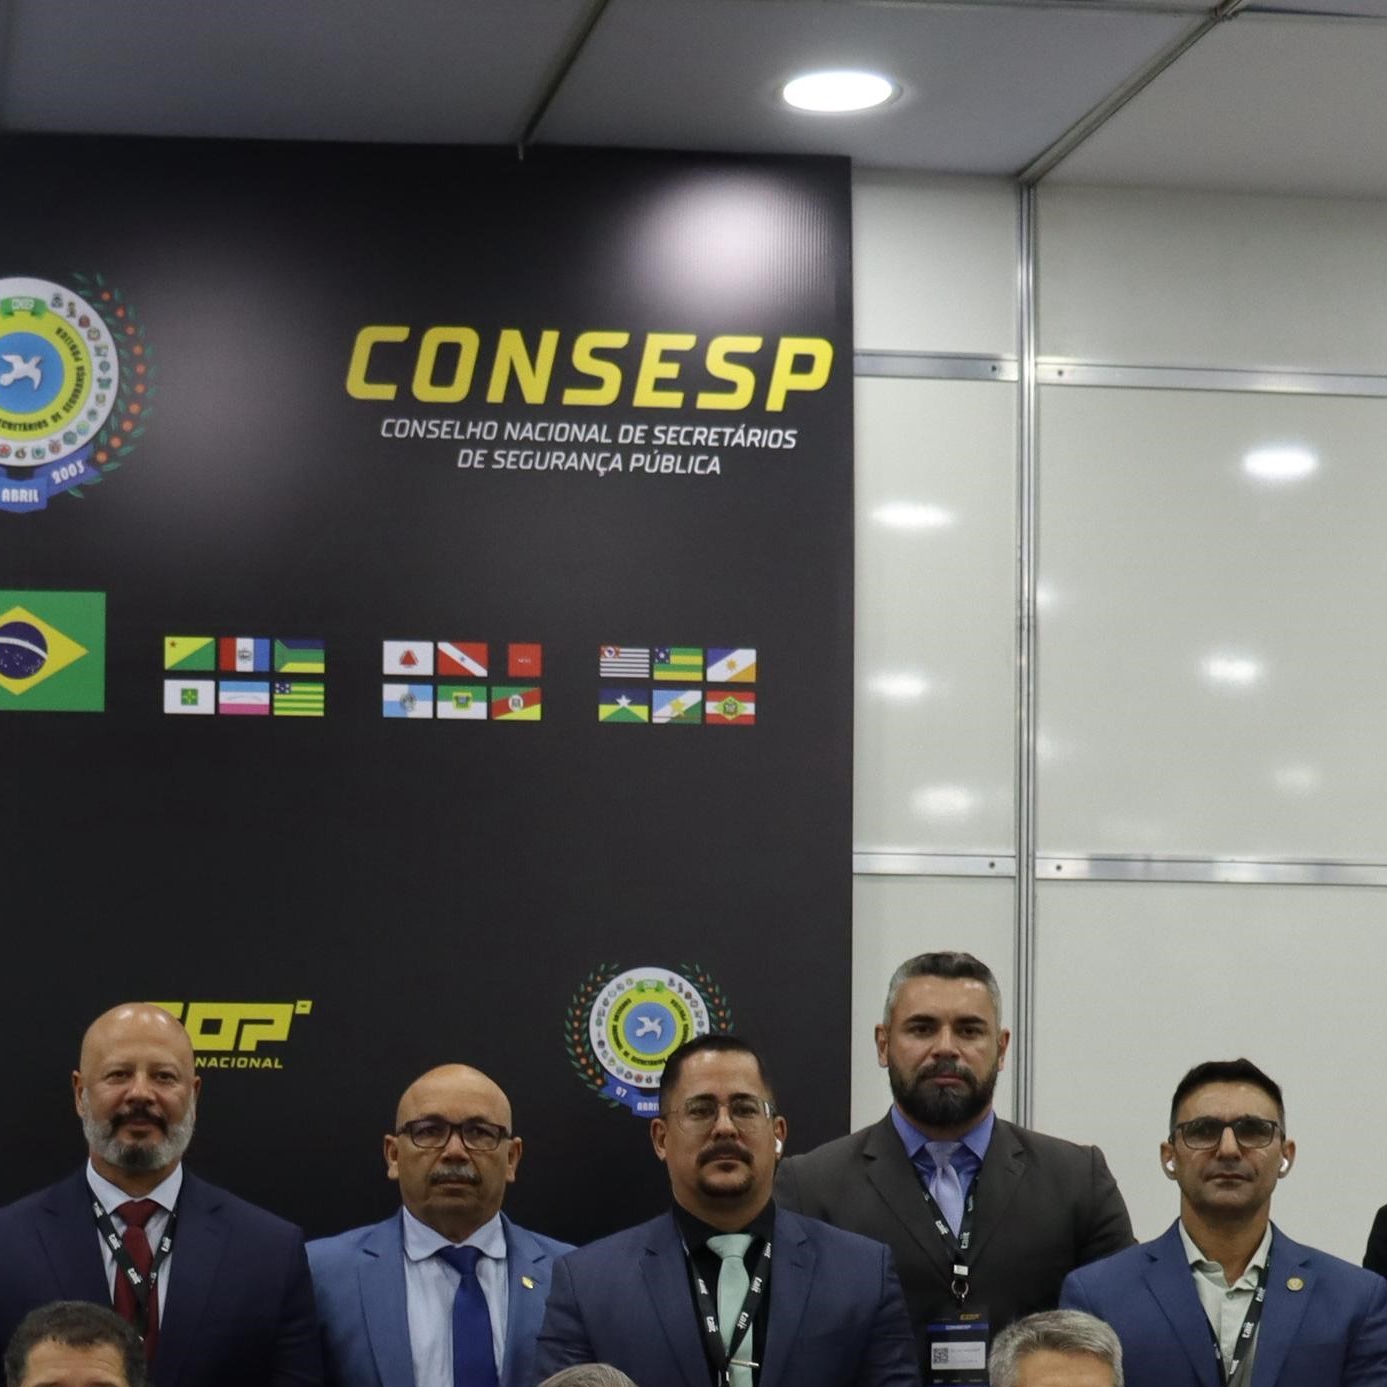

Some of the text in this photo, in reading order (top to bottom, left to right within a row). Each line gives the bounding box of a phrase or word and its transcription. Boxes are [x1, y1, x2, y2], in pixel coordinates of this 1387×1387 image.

[345, 325, 834, 412] CONSESP
[380, 418, 798, 449] CONSELHO NACIONAL DE SECRETÁRIOS
[457, 449, 721, 476] DE SEGURANÇA PÚBLICA
[1, 488, 39, 503] ABRIL
[148, 1002, 295, 1051] OP
[195, 1056, 284, 1069] NACIONAL
